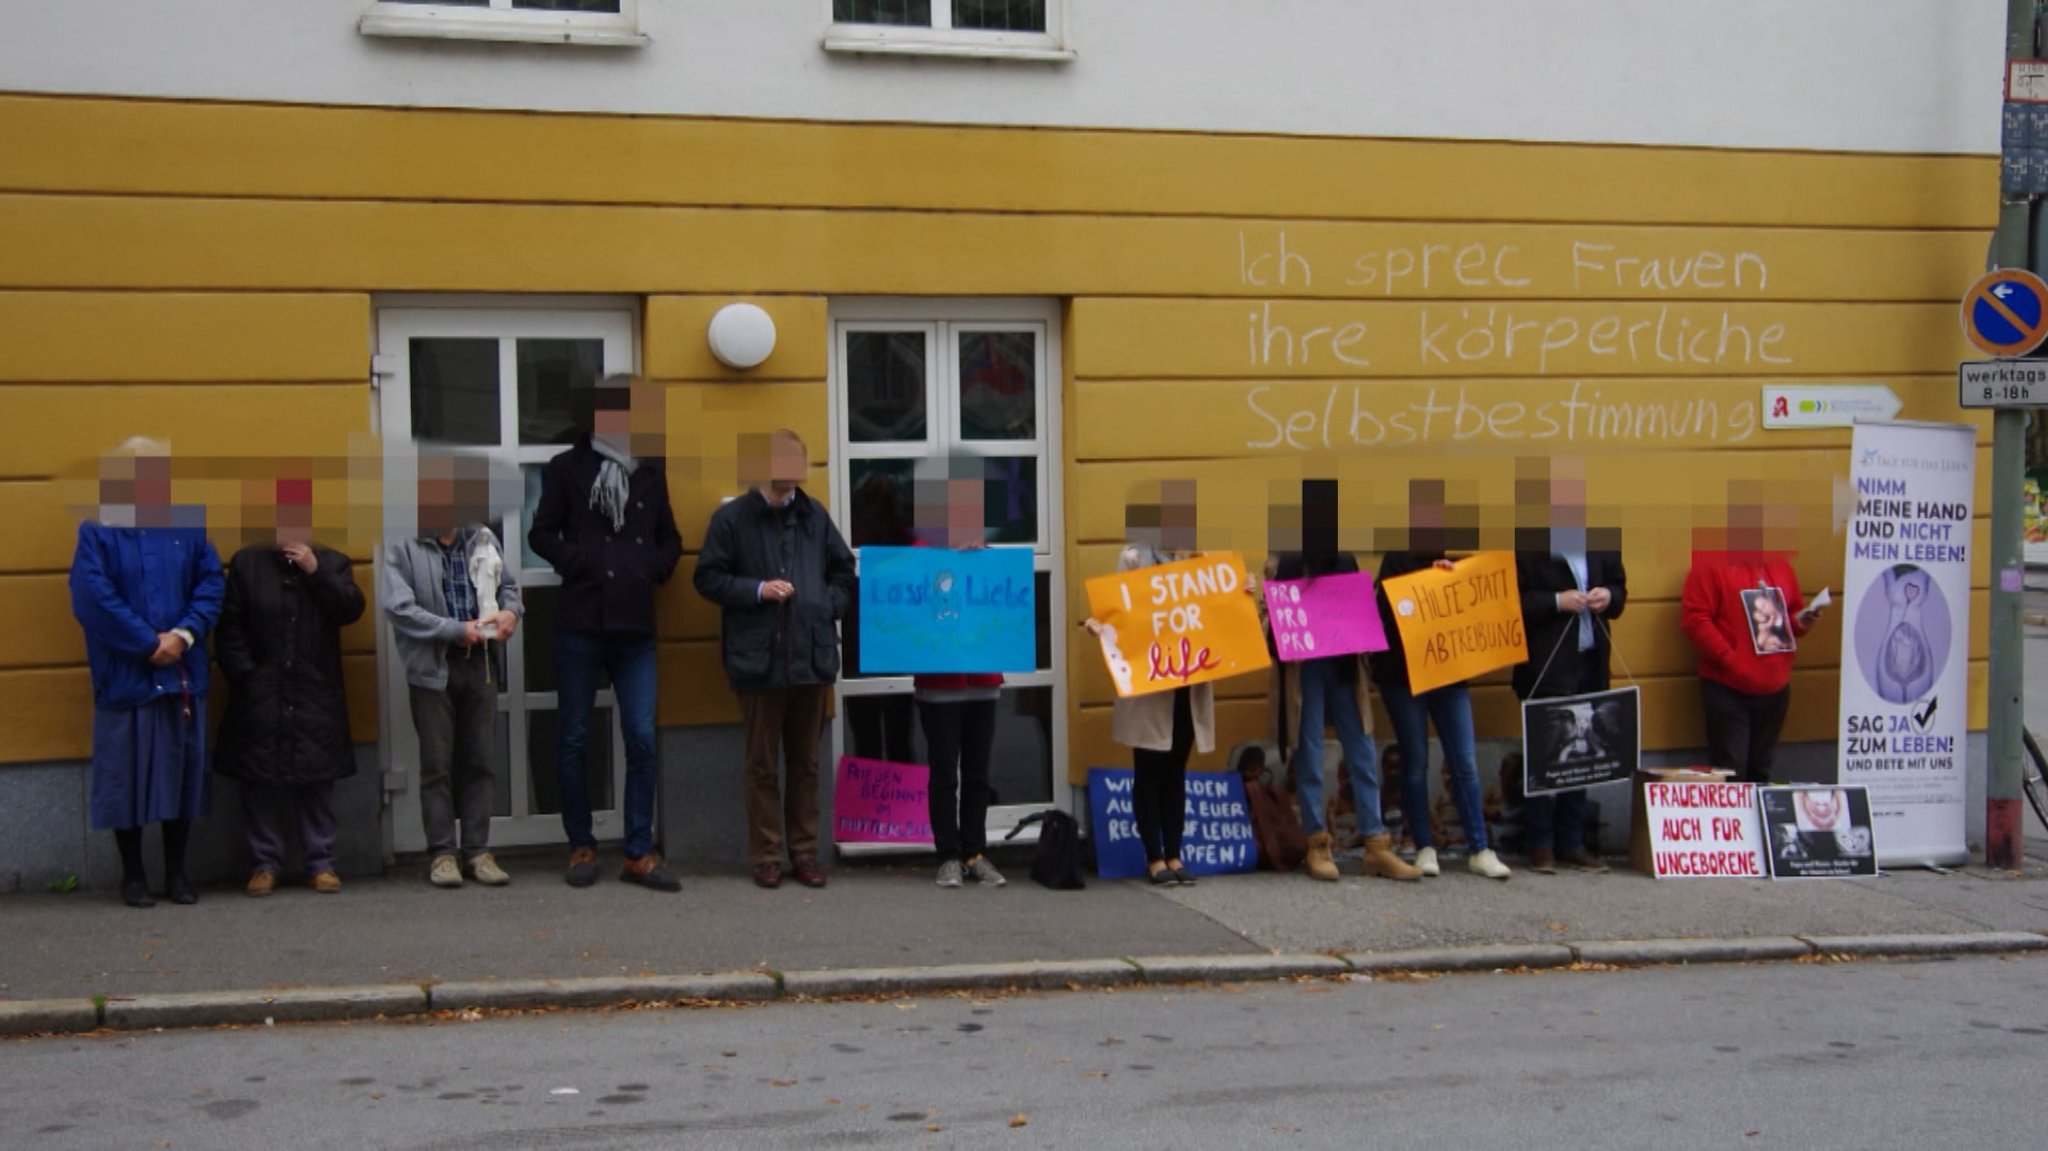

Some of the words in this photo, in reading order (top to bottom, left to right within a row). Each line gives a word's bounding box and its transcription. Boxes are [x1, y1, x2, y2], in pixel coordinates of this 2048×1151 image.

[1239, 230, 1311, 288] Ich
[1346, 240, 1531, 295] sprec
[1572, 240, 1767, 291] Frauen
[1249, 301, 1370, 366] ihre
[1419, 303, 1793, 374] körperliche
[1967, 369, 2046, 385] werktags
[1247, 380, 1757, 450] Selbstbestimmung
[1857, 477, 1906, 496] NIMM
[1857, 498, 1912, 519] MEINE
[1917, 502, 1968, 521] HAND
[1855, 520, 1895, 538] UND
[1899, 523, 1952, 541] NICHT
[1854, 542, 1899, 560] MEIN
[1904, 544, 1966, 562] LEBEN!
[1120, 582, 1132, 612] I
[1151, 563, 1238, 606] STAND
[1270, 584, 1301, 604] PRO
[1412, 581, 1464, 623] HILFE
[1468, 567, 1509, 608] STATT
[1152, 604, 1204, 637] FOR
[1276, 608, 1309, 629] PRO
[1281, 631, 1316, 652] PRO
[1423, 616, 1523, 668] ABTREIBUNG
[1148, 636, 1222, 684] life
[1847, 715, 1884, 734] SAG
[1888, 715, 1911, 733] JA
[1846, 736, 1887, 755] ZUM
[1892, 736, 1954, 754] LEBEN!
[1846, 758, 1873, 771] UND
[1875, 758, 1905, 770] BETE
[1907, 758, 1927, 770] MIT
[1929, 757, 1954, 770] UNS
[1649, 783, 1754, 808] FRAUENRECHT
[1200, 801, 1244, 817] EUER
[1202, 821, 1252, 841] LEBEN
[1662, 816, 1702, 841] AUCH
[1656, 850, 1760, 876] UNGEBORENE
